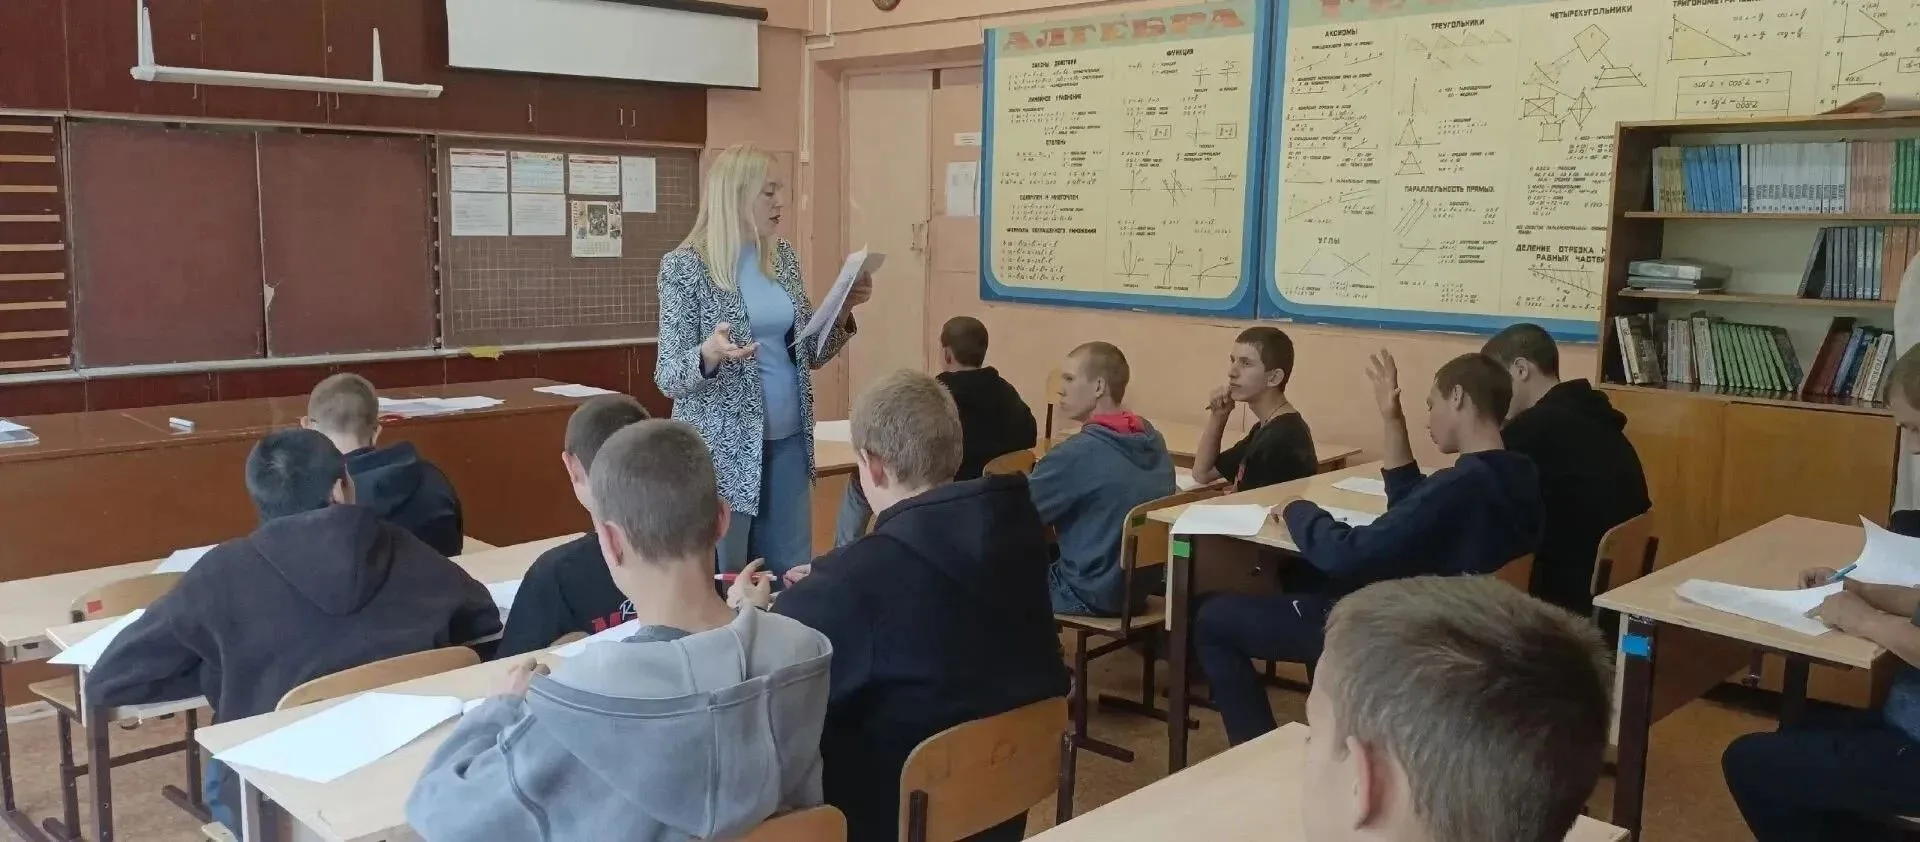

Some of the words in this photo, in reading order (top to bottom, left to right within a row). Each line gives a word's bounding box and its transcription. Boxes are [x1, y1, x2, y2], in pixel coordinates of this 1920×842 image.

[1550, 5, 1633, 19] ЧЕТЫРЕХУГОЛЬНИКИ
[1431, 18, 1485, 30] ТРЕУГОЛЬНИКИ
[1002, 8, 1245, 51] АЛГЕБРА
[1325, 28, 1358, 37] АКСИОМЫ
[1404, 185, 1464, 193] ПАРАЛЛЕЛЬНОСТЬ
[1515, 244, 1551, 253] ДЕЛЕНИЕ
[1558, 245, 1594, 254] ОТРЕЗКА
[1536, 253, 1569, 262] РАВНЫХ
